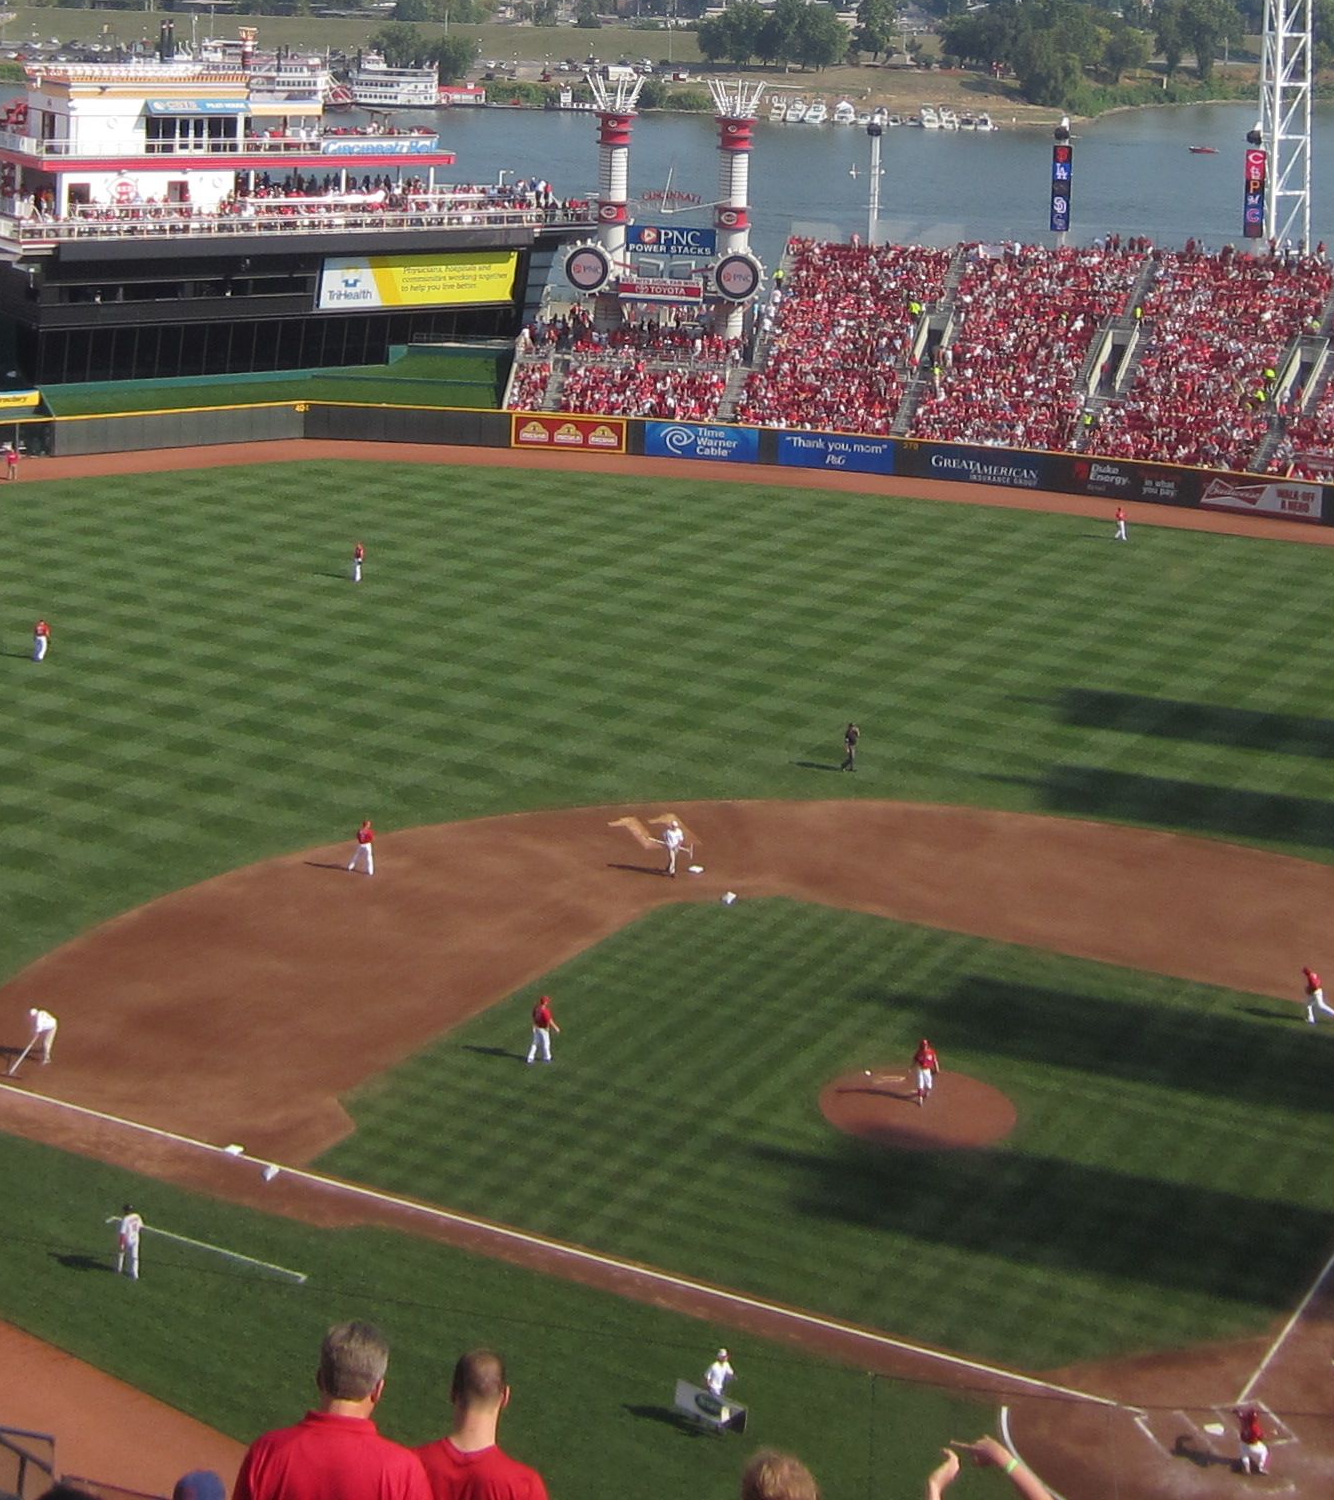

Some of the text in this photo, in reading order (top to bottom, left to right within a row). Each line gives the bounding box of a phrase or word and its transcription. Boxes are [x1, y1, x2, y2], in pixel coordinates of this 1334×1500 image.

[659, 230, 701, 246] PNC
[629, 243, 711, 255] POWER STACKS
[583, 264, 602, 275] PNC
[733, 273, 753, 283] PNC
[327, 289, 372, 301] TriHealth
[650, 286, 686, 295] TOYOTA
[696, 427, 725, 438] Time
[696, 436, 738, 448] Warner
[786, 436, 887, 454] "Thank you, mom"
[696, 446, 728, 457] Cable
[825, 454, 845, 465] P&G
[1091, 463, 1120, 474] Duke
[969, 474, 1011, 485] INSURANCE
[1089, 473, 1128, 486] Energy
[1156, 478, 1175, 489] what
[1142, 486, 1158, 496] you
